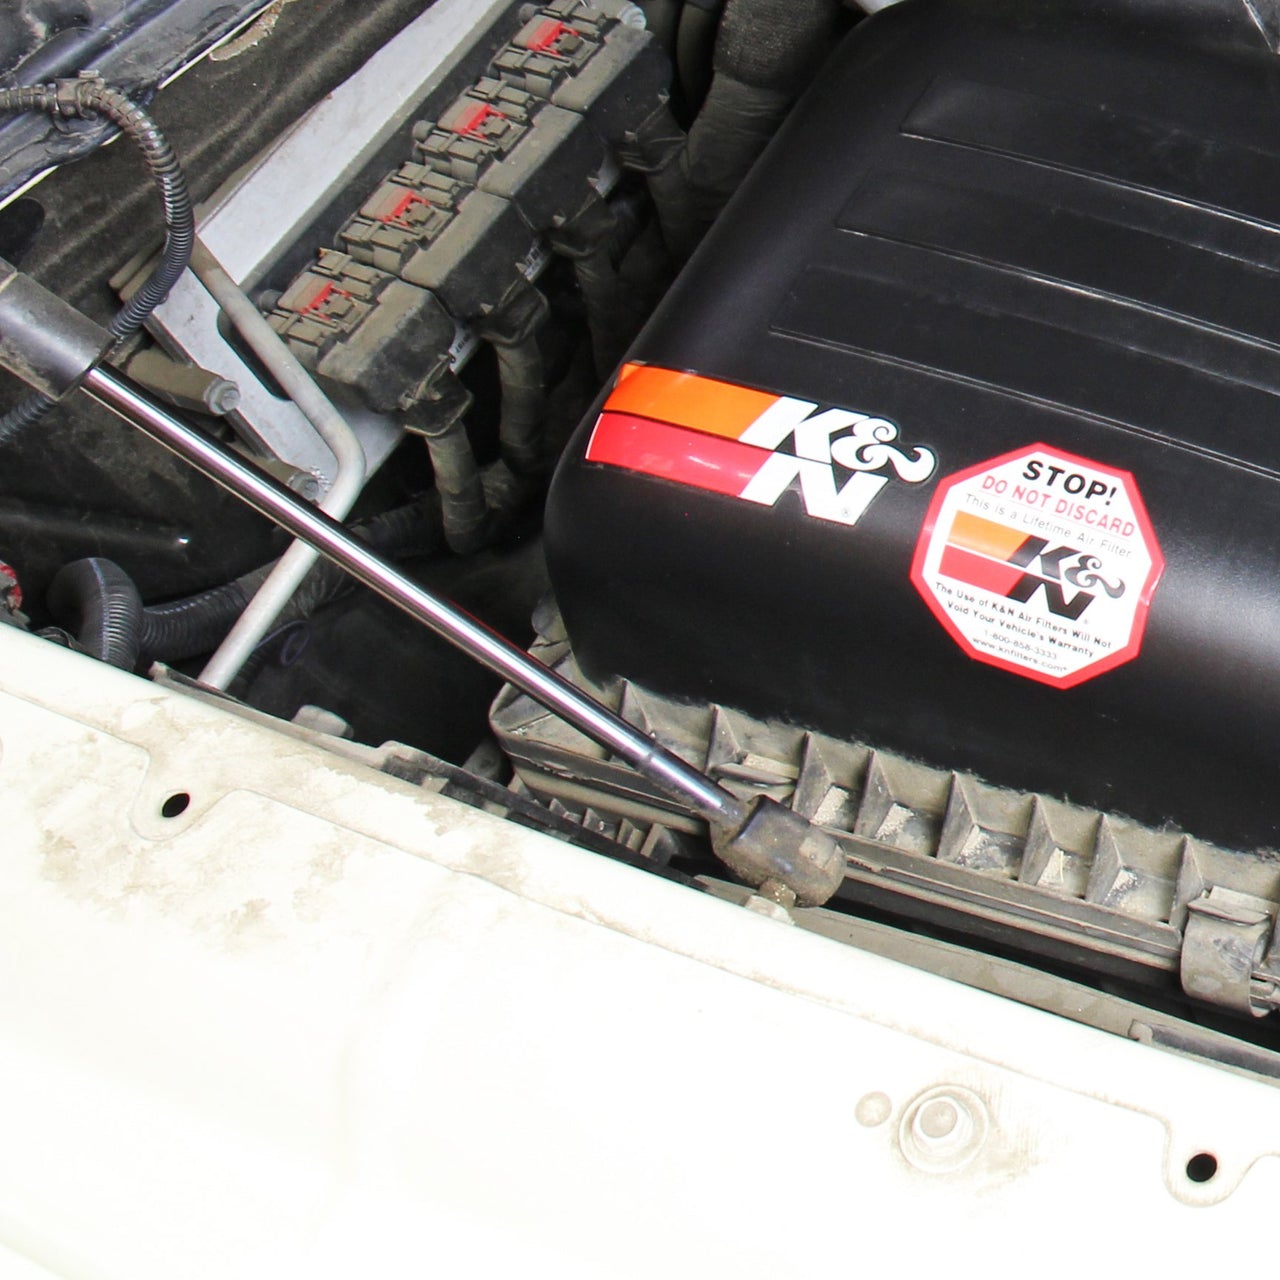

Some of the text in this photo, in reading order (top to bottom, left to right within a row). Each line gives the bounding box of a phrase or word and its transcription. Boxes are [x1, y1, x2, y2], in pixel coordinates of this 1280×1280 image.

[738, 394, 936, 526] K&N
[1022, 460, 1117, 506] STOP!
[965, 493, 1132, 558] This is a Lifetime Air Filter
[981, 475, 1135, 538] DO NOT DISCARD
[1007, 535, 1126, 621] K&N
[935, 581, 1112, 650] The Use of K&N Air Filters Will Not
[947, 600, 1095, 659] Void Your Vehicle's Warranty
